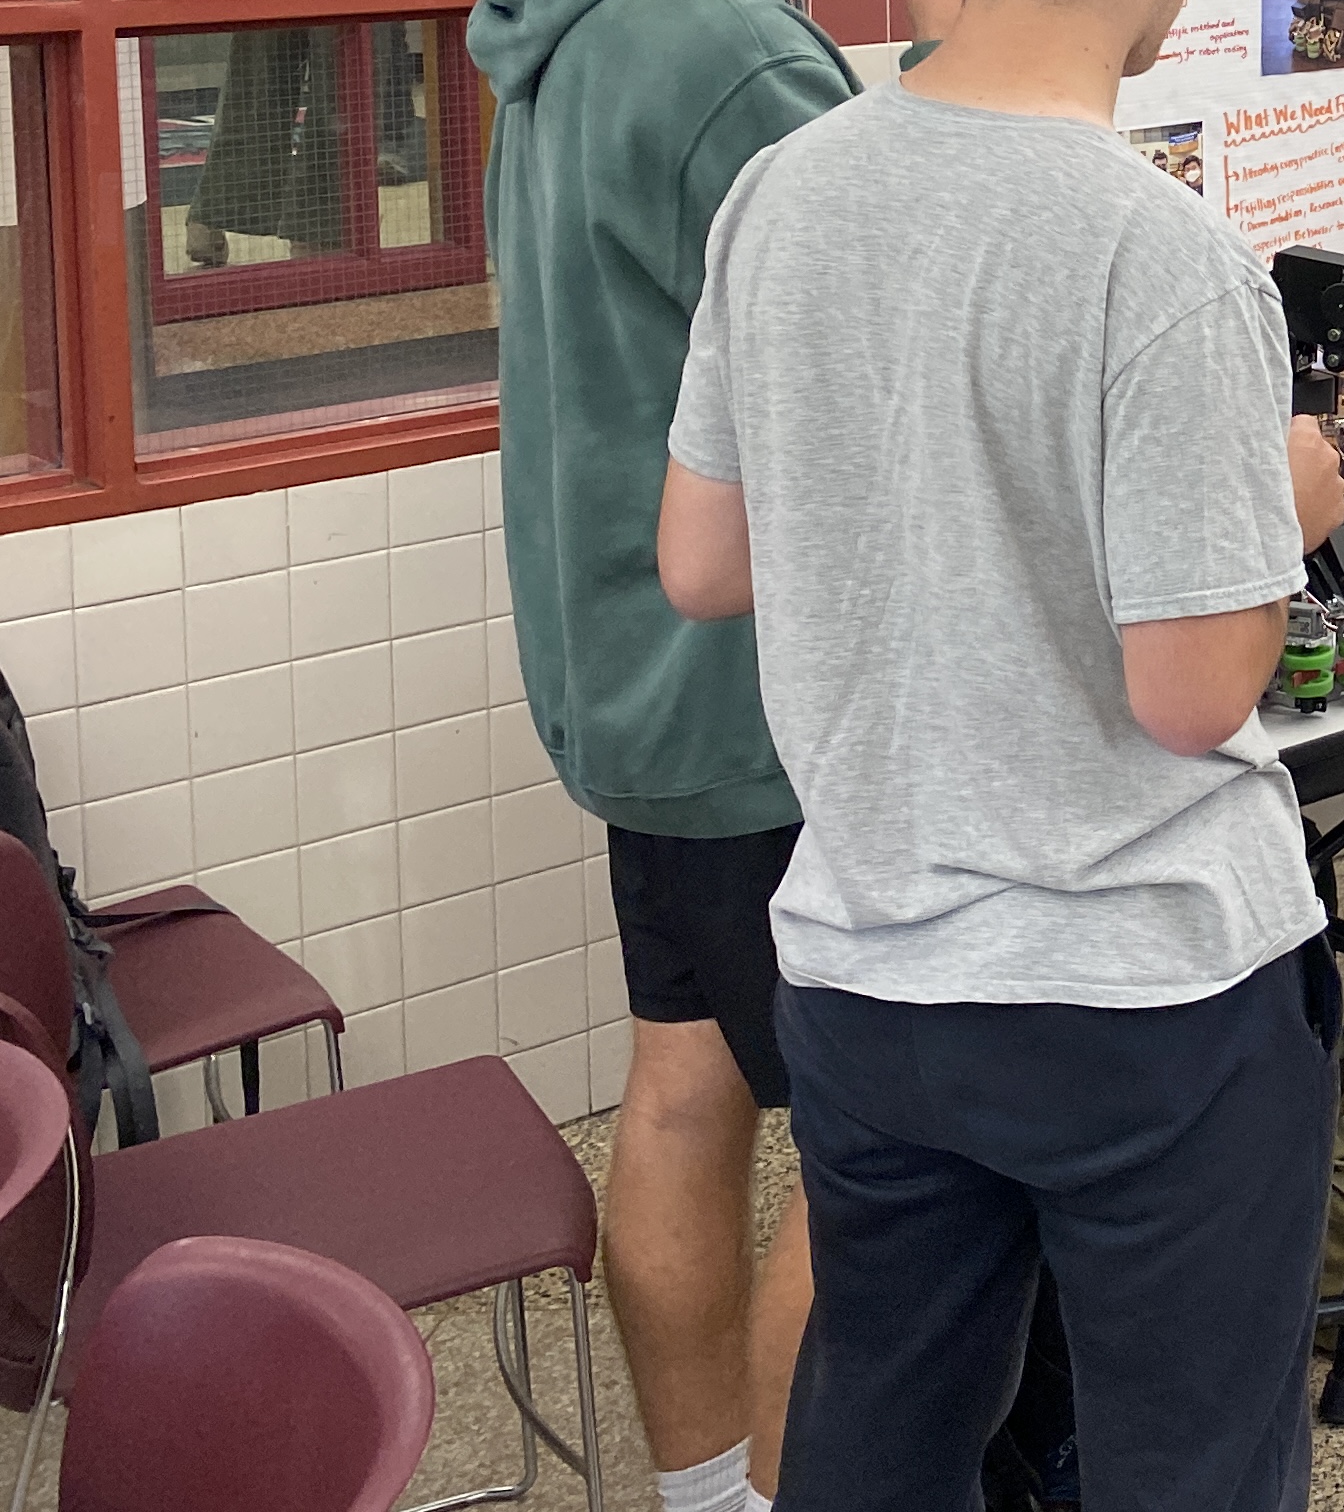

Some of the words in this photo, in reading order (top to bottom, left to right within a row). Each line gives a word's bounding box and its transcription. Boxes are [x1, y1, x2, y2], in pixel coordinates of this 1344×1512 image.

[1184, 47, 1197, 62] for
[1199, 47, 1220, 56] robot
[1224, 44, 1248, 59] coding
[1223, 108, 1270, 136] What
[1273, 104, 1298, 125] We
[1300, 99, 1332, 121] Need
